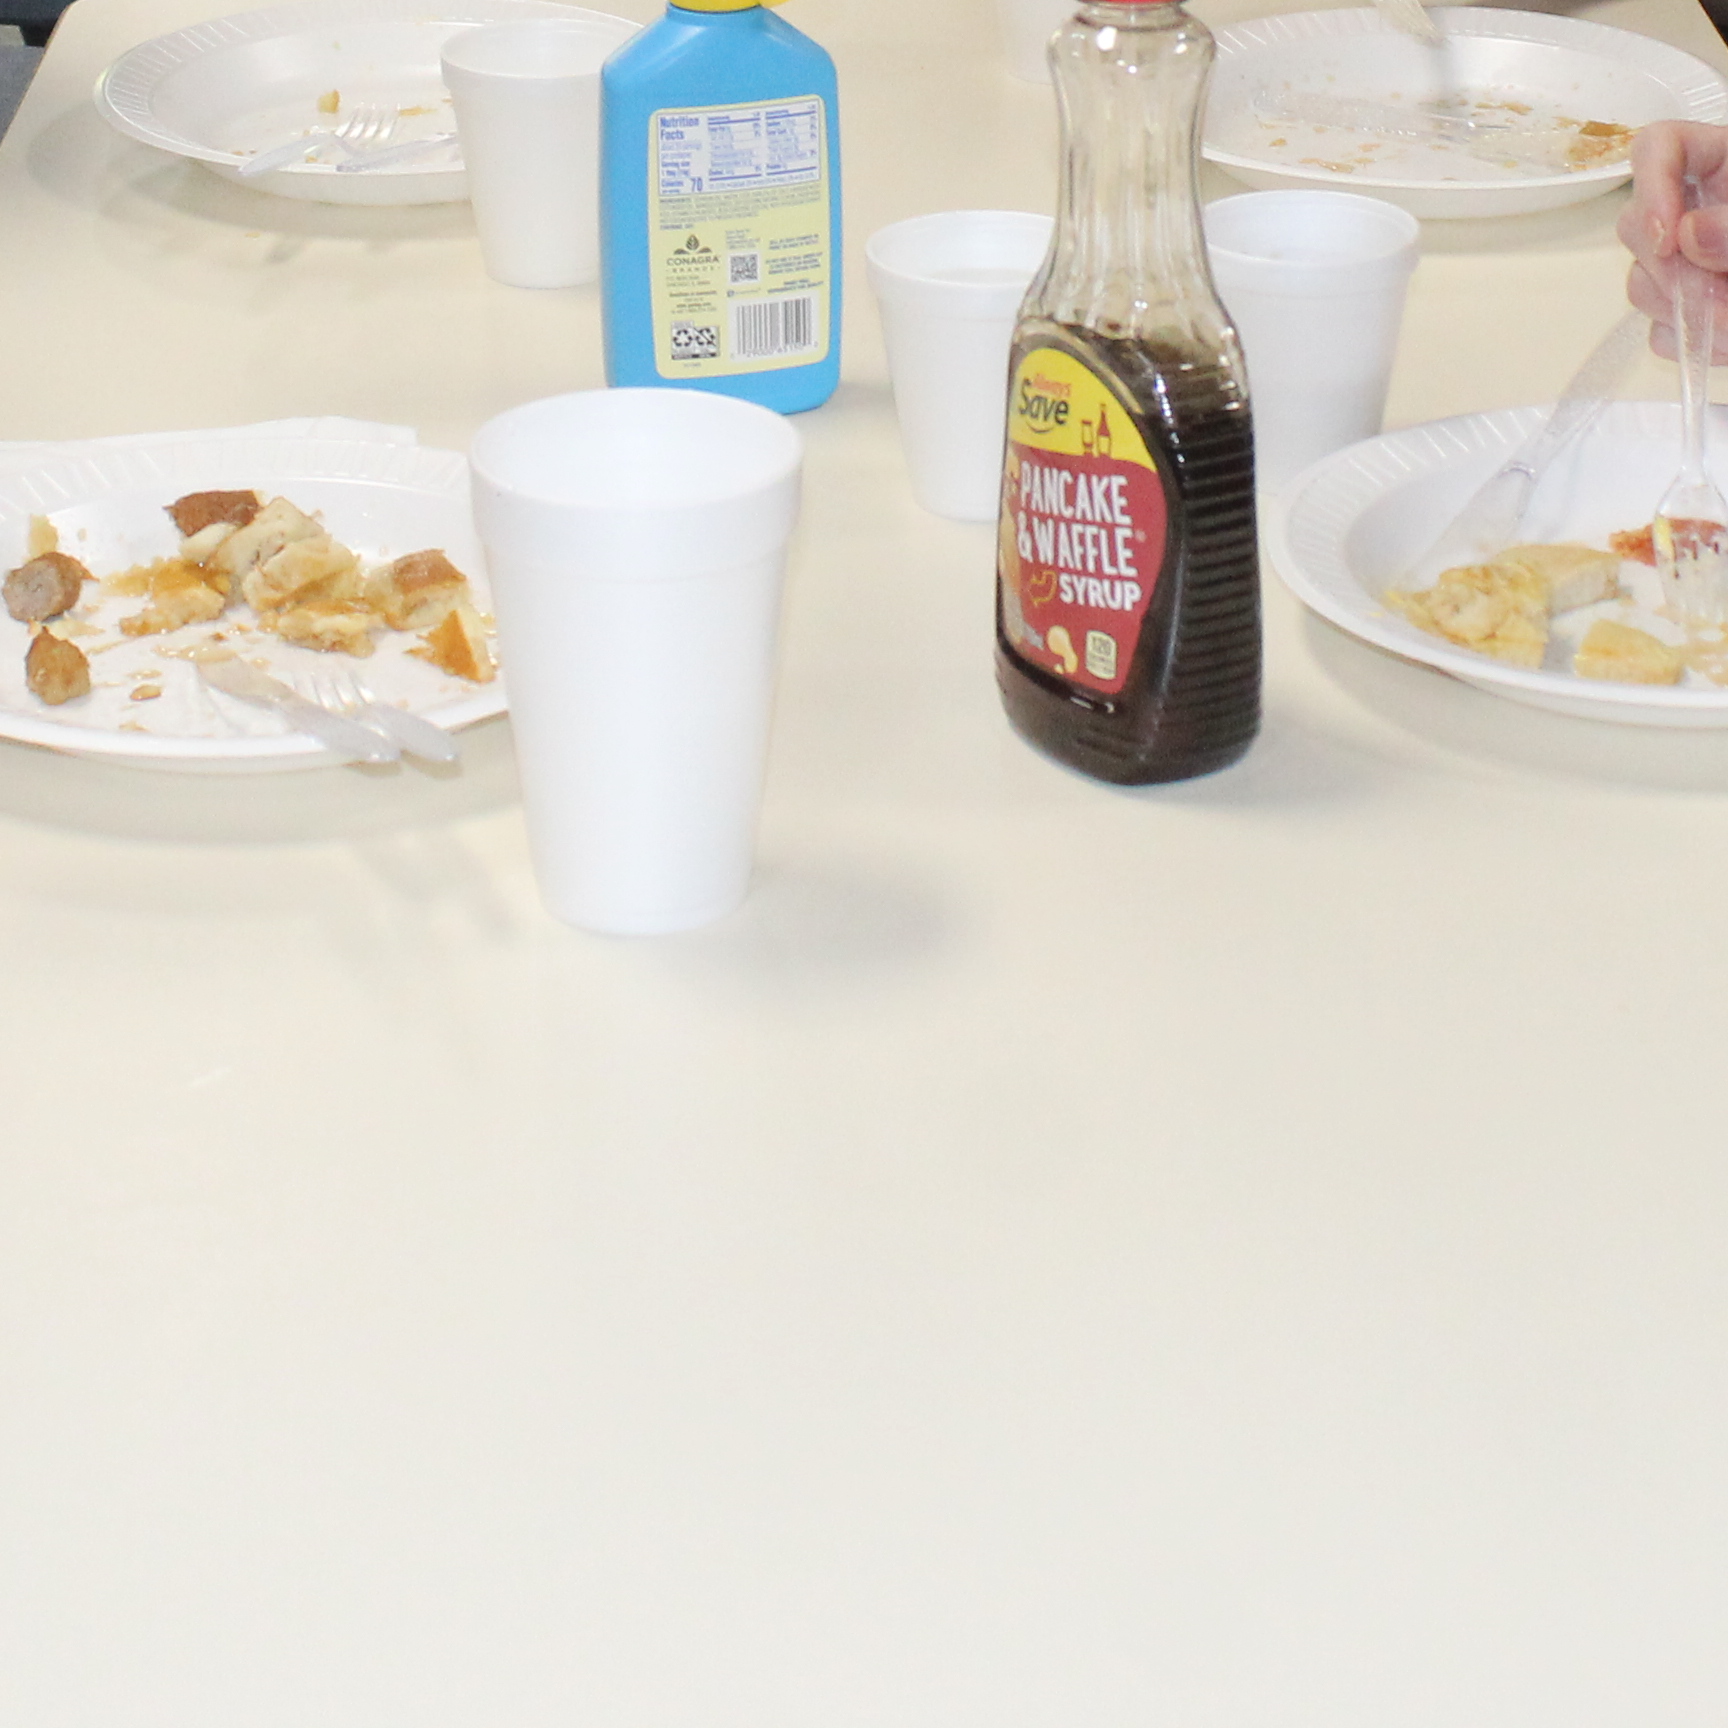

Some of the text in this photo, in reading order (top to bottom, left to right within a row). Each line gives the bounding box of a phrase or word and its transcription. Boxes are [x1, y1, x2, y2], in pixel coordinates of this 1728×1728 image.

[660, 116, 699, 128] Nutrition
[660, 129, 685, 141] Facts
[691, 176, 703, 192] 70
[666, 255, 720, 266] CONAGRA
[1019, 378, 1069, 426] Save
[1021, 461, 1133, 525] PANCAKE
[1018, 510, 1138, 578] & WAFFLE
[1059, 572, 1142, 611] SYRUP
